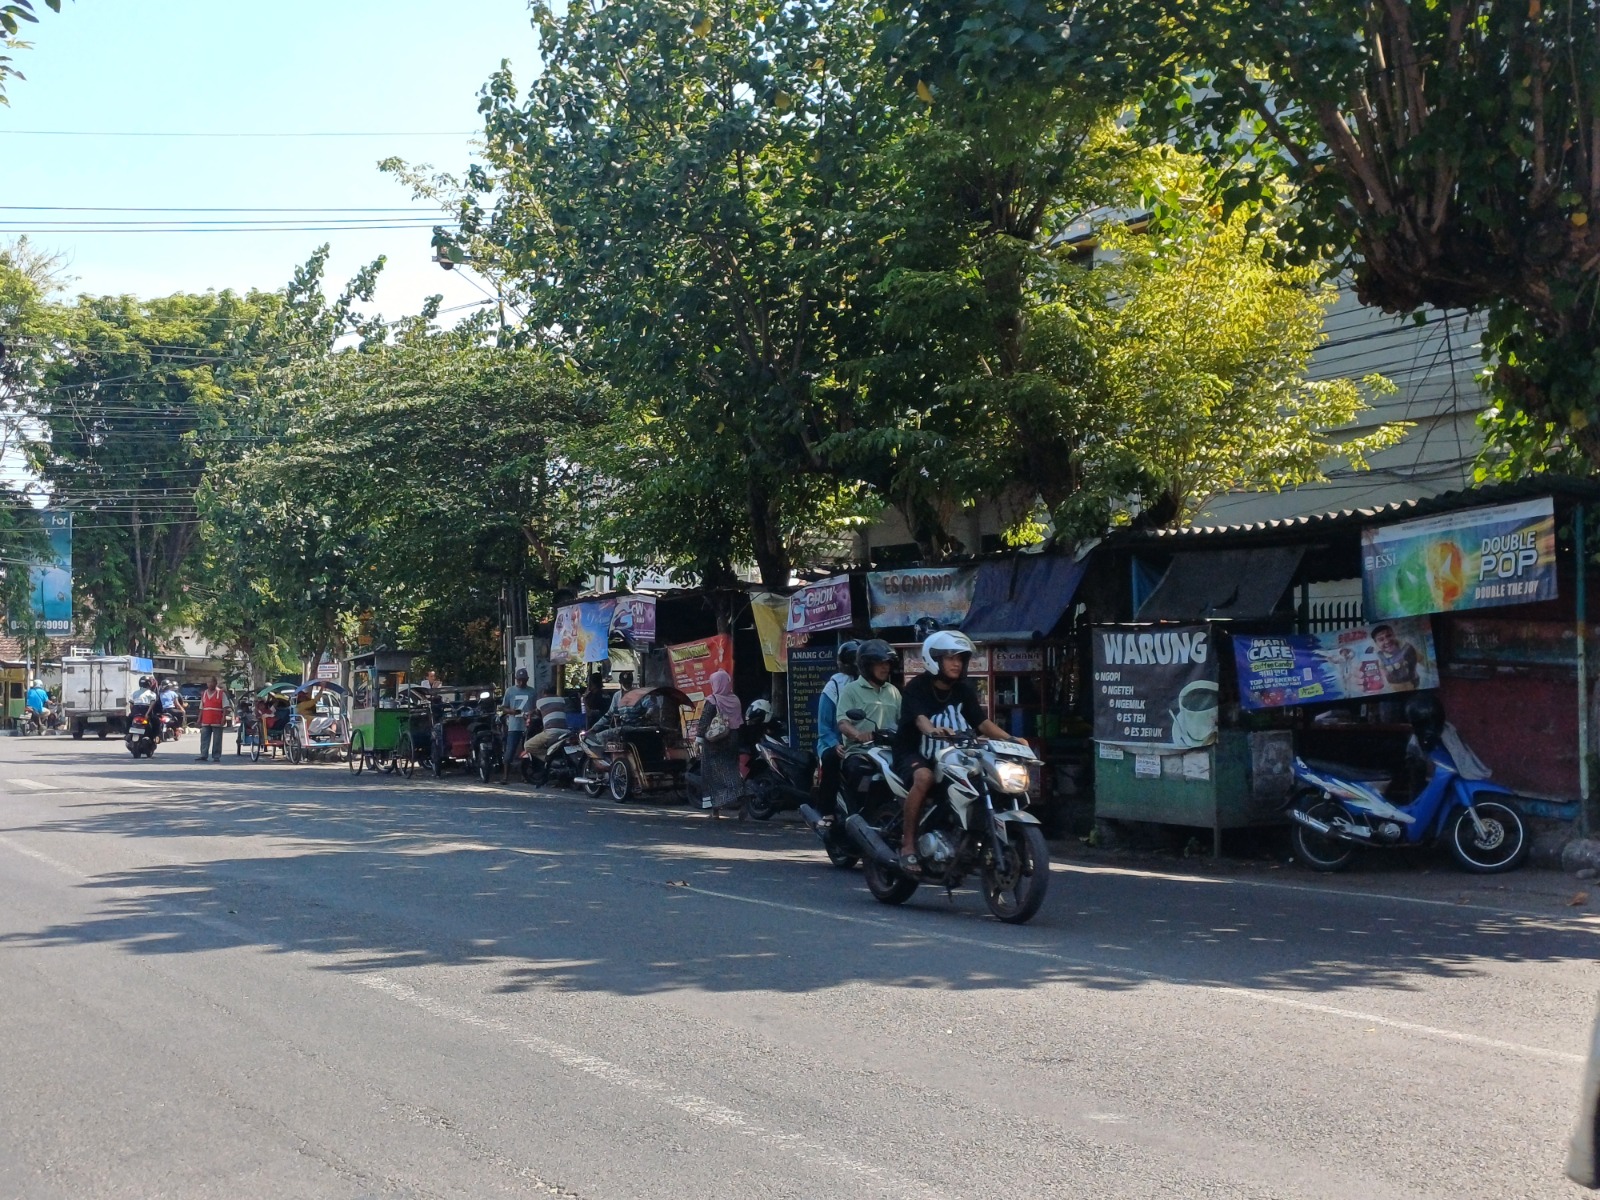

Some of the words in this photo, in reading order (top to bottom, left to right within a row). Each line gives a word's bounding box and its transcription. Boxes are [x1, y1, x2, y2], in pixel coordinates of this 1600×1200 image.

[1481, 532, 1537, 555] DOUBLE
[1479, 550, 1538, 582] POP
[1475, 584, 1505, 600] DOUBLE
[1507, 582, 1524, 596] THE
[1524, 580, 1539, 595] JOY
[1102, 632, 1208, 665] WARUNG
[1253, 639, 1285, 648] MARI
[792, 651, 817, 659] ANANG
[818, 650, 833, 659] Cell
[1250, 646, 1294, 661] CAFE
[1100, 672, 1121, 682] NGOPI
[1274, 676, 1301, 684] ENERGY
[1107, 685, 1134, 695] NGETEH
[1122, 714, 1132, 723] ES
[1133, 713, 1146, 723] TEH
[1130, 727, 1140, 737] ES
[1140, 728, 1163, 738] JERUK
